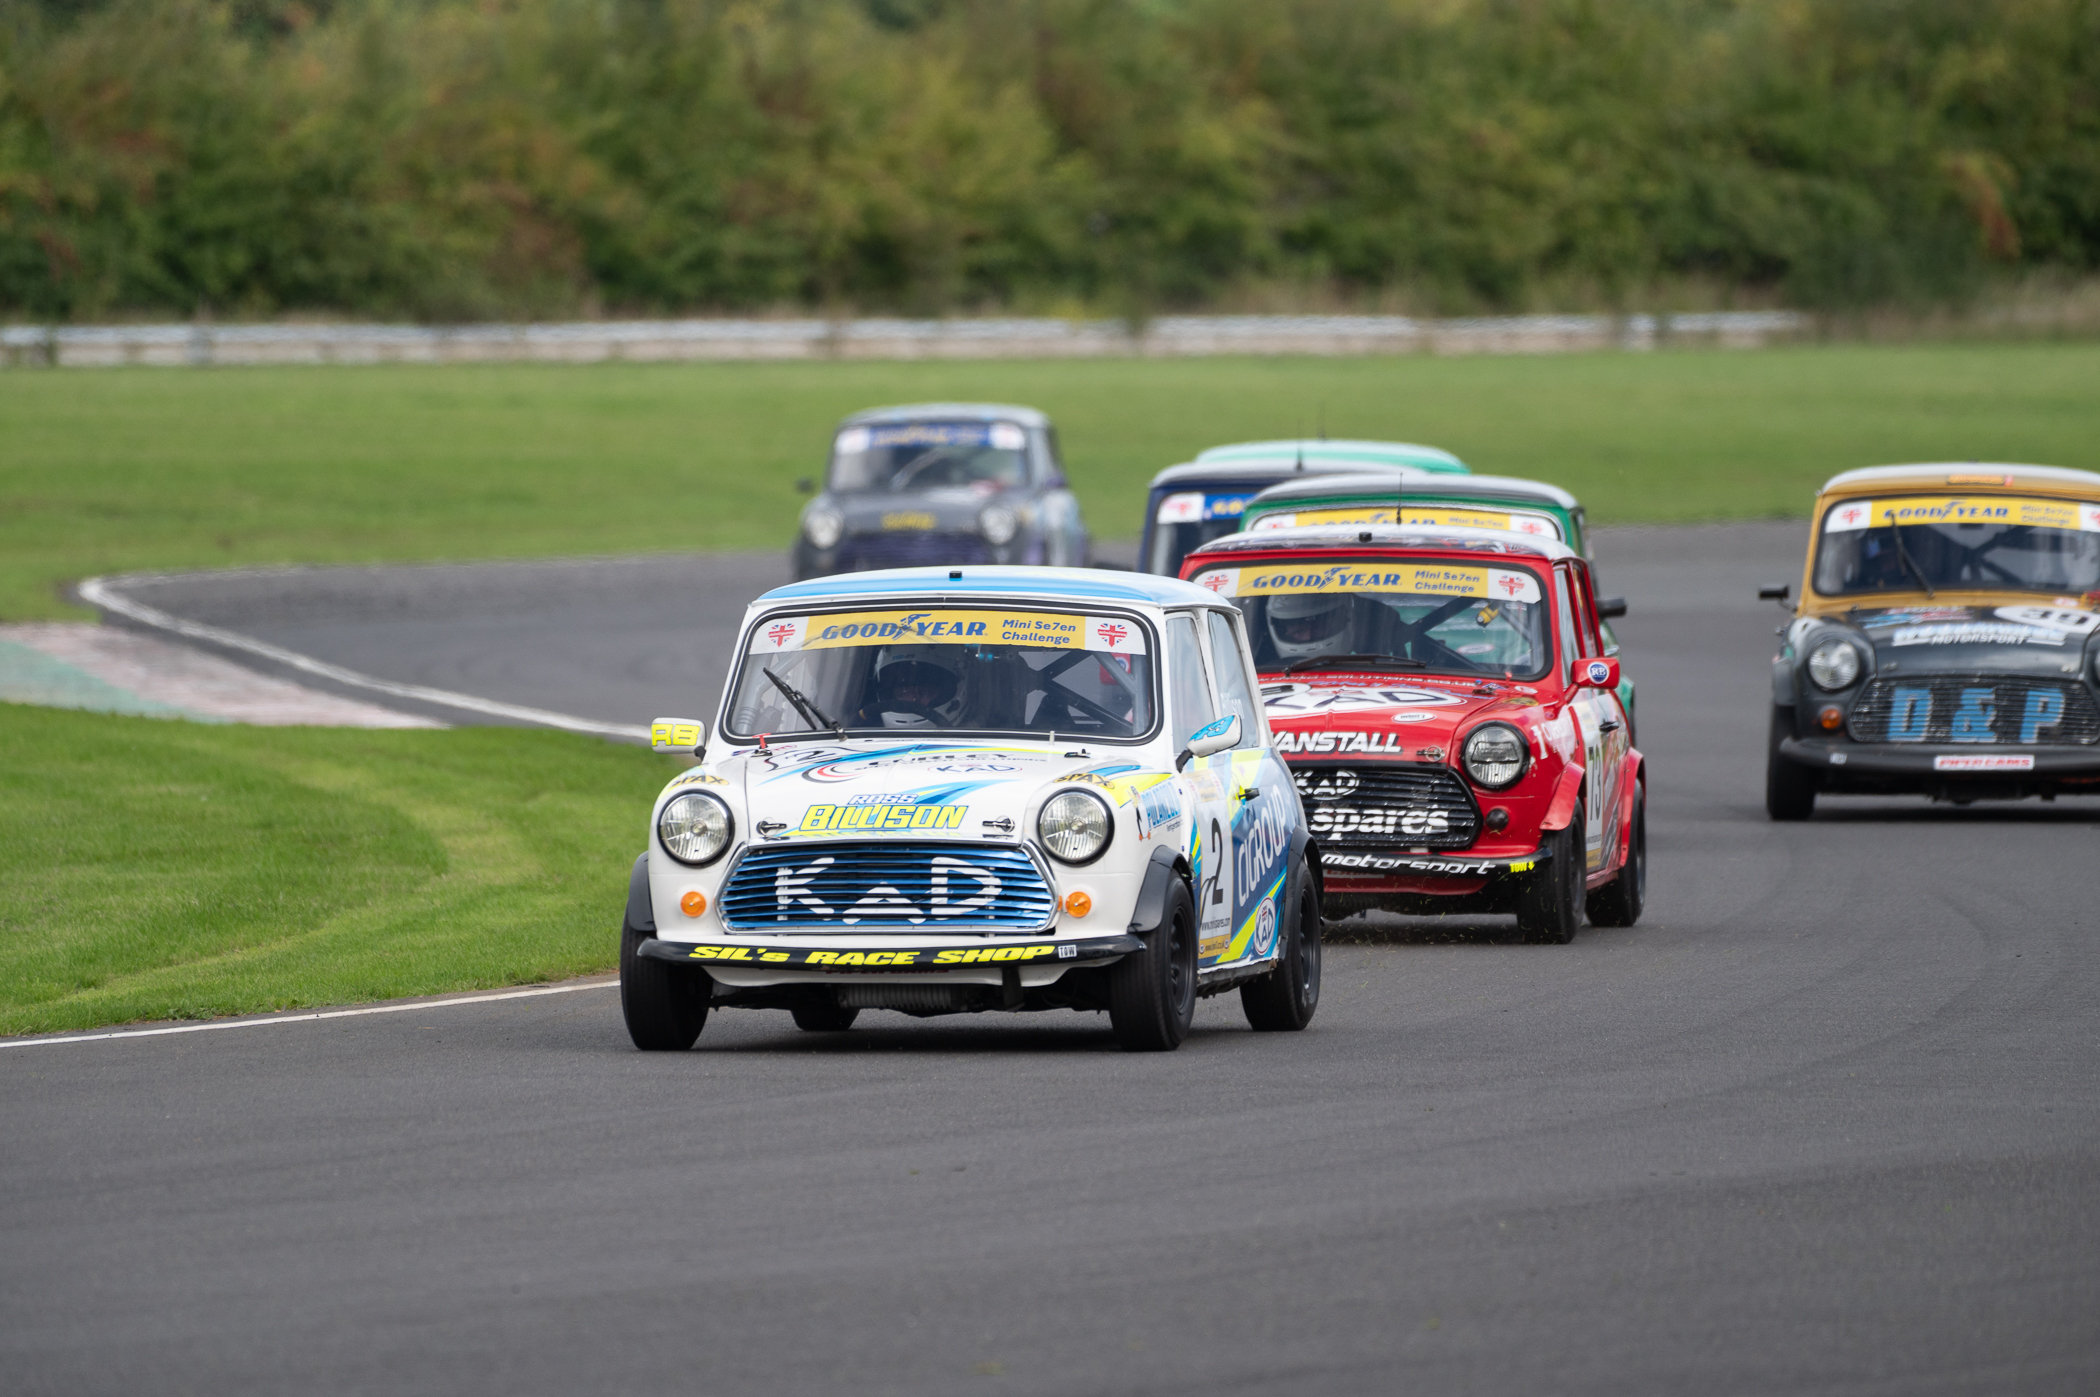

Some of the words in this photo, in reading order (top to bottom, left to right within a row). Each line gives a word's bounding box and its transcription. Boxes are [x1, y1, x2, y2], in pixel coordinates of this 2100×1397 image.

[1414, 570, 1440, 580] Mini
[1443, 571, 1480, 583] Se7en
[1414, 582, 1475, 594] Challenge
[1002, 619, 1032, 629] Mini
[1035, 620, 1076, 632] Se7en
[1002, 631, 1070, 645] Challenge
[1886, 686, 1934, 743] D
[1951, 687, 1998, 743] &
[2019, 687, 2066, 744] P
[651, 723, 701, 747] RB
[848, 793, 919, 805] ROSS
[799, 803, 969, 831] BILLISON
[1310, 807, 1449, 841] spares
[1211, 817, 1224, 906] 2
[1321, 852, 1496, 875] motorsport
[1509, 862, 1527, 873] TOW
[774, 856, 1002, 925] KAD
[804, 950, 921, 966] RACE
[932, 945, 1056, 965] SHOP
[1058, 945, 1077, 957] TOW
